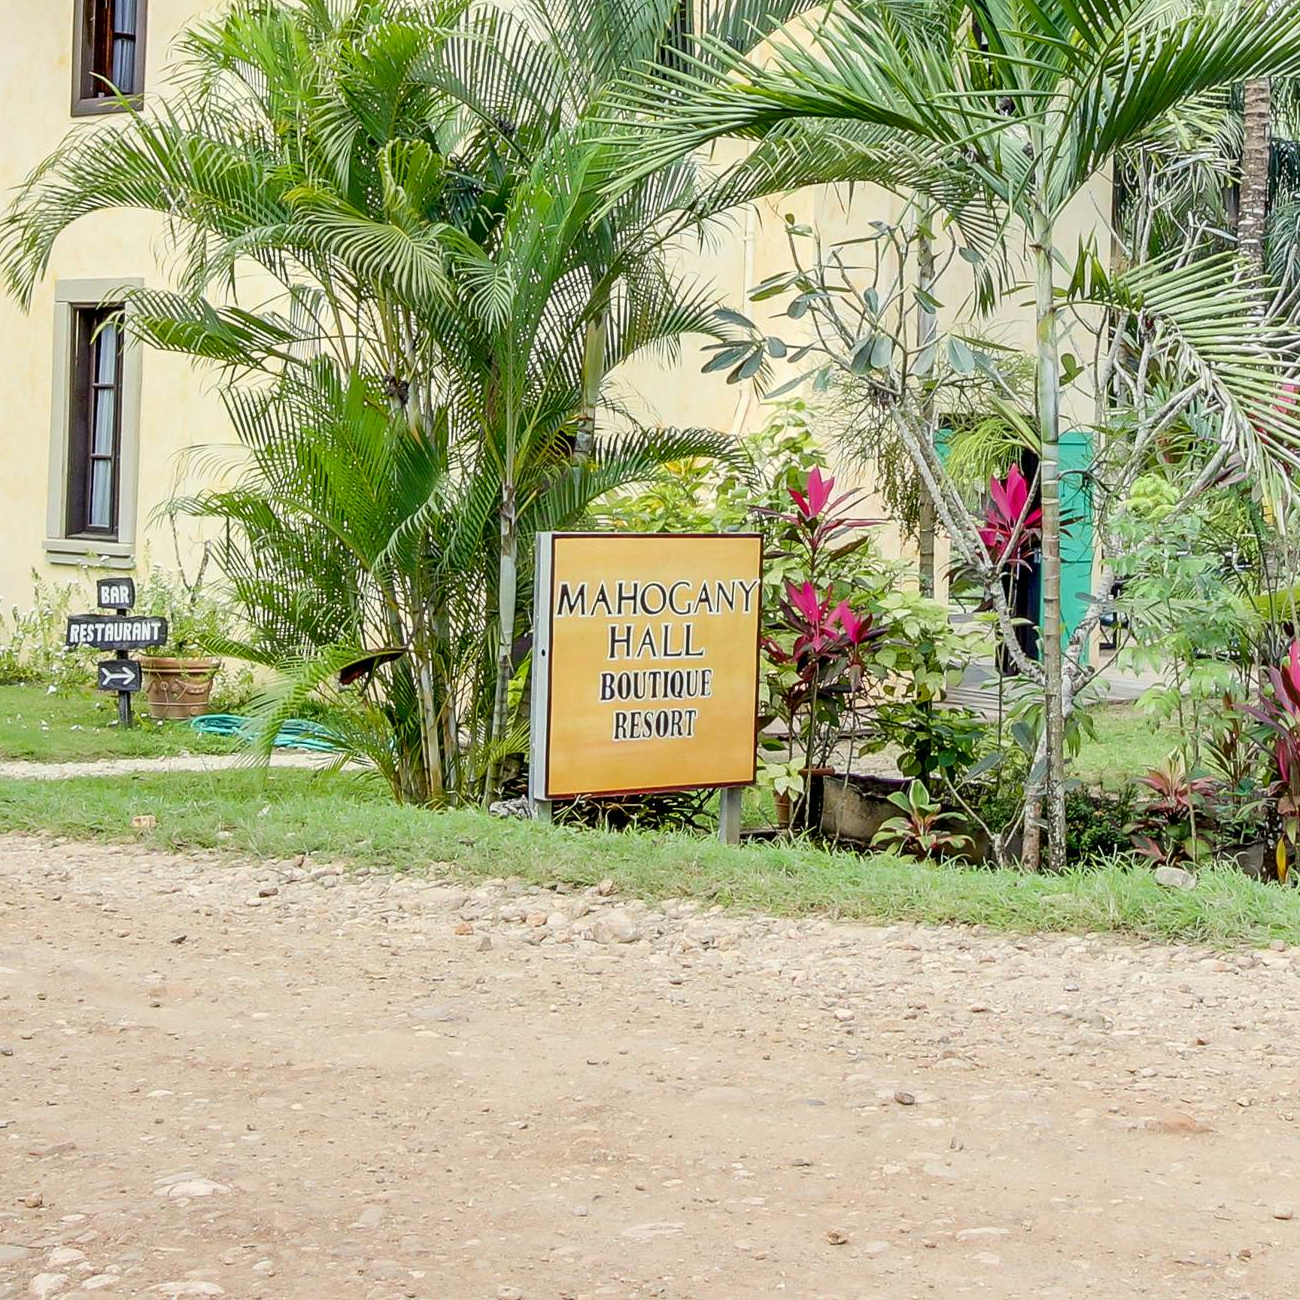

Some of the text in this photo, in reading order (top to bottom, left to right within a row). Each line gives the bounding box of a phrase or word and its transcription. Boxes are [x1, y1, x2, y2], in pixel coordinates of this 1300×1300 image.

[100, 585, 130, 604] BAR
[556, 579, 759, 616] MAHOGANY
[69, 622, 162, 643] RESTAURANT
[608, 623, 705, 659] HALL
[600, 669, 712, 701] BOUTIQUE
[613, 709, 697, 740] RESORT
